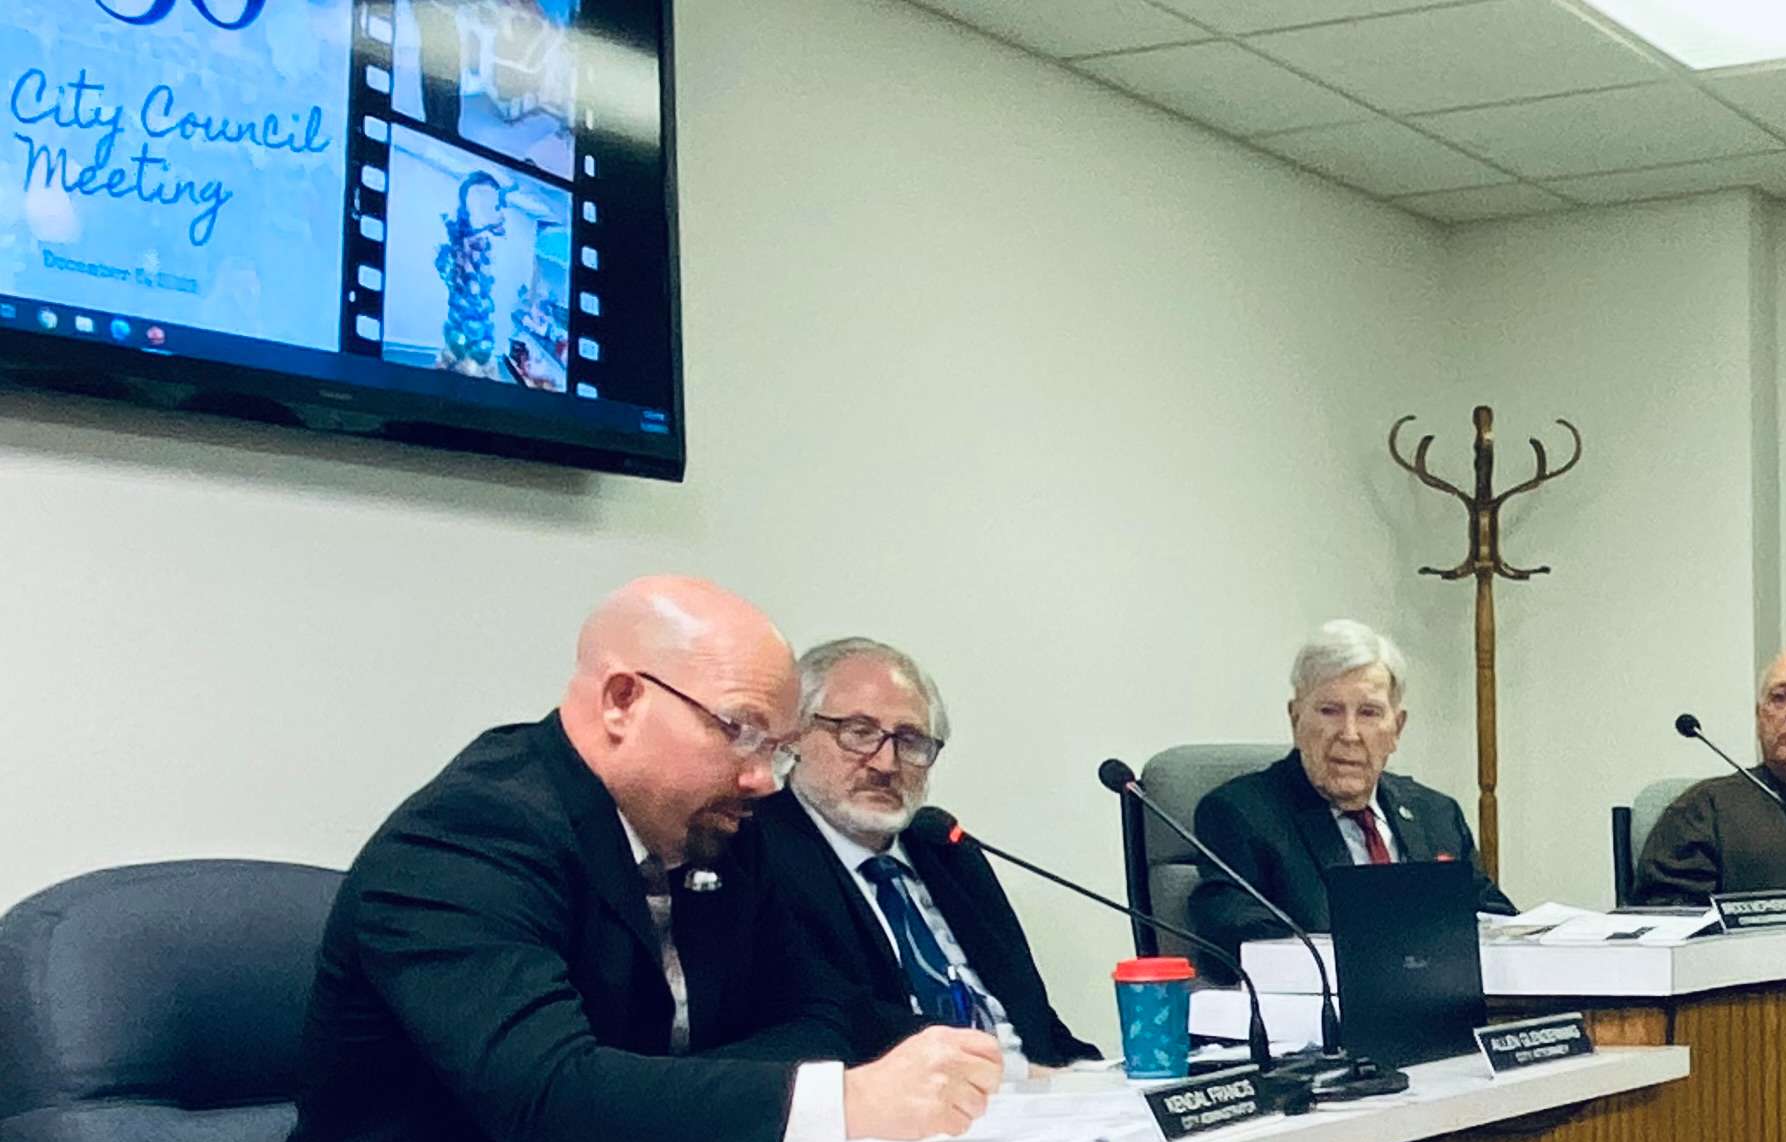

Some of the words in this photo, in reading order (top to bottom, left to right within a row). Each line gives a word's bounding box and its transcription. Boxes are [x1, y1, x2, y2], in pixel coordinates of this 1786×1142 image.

[10, 67, 124, 166] City
[141, 84, 331, 154] Council
[15, 133, 234, 246] Meeting
